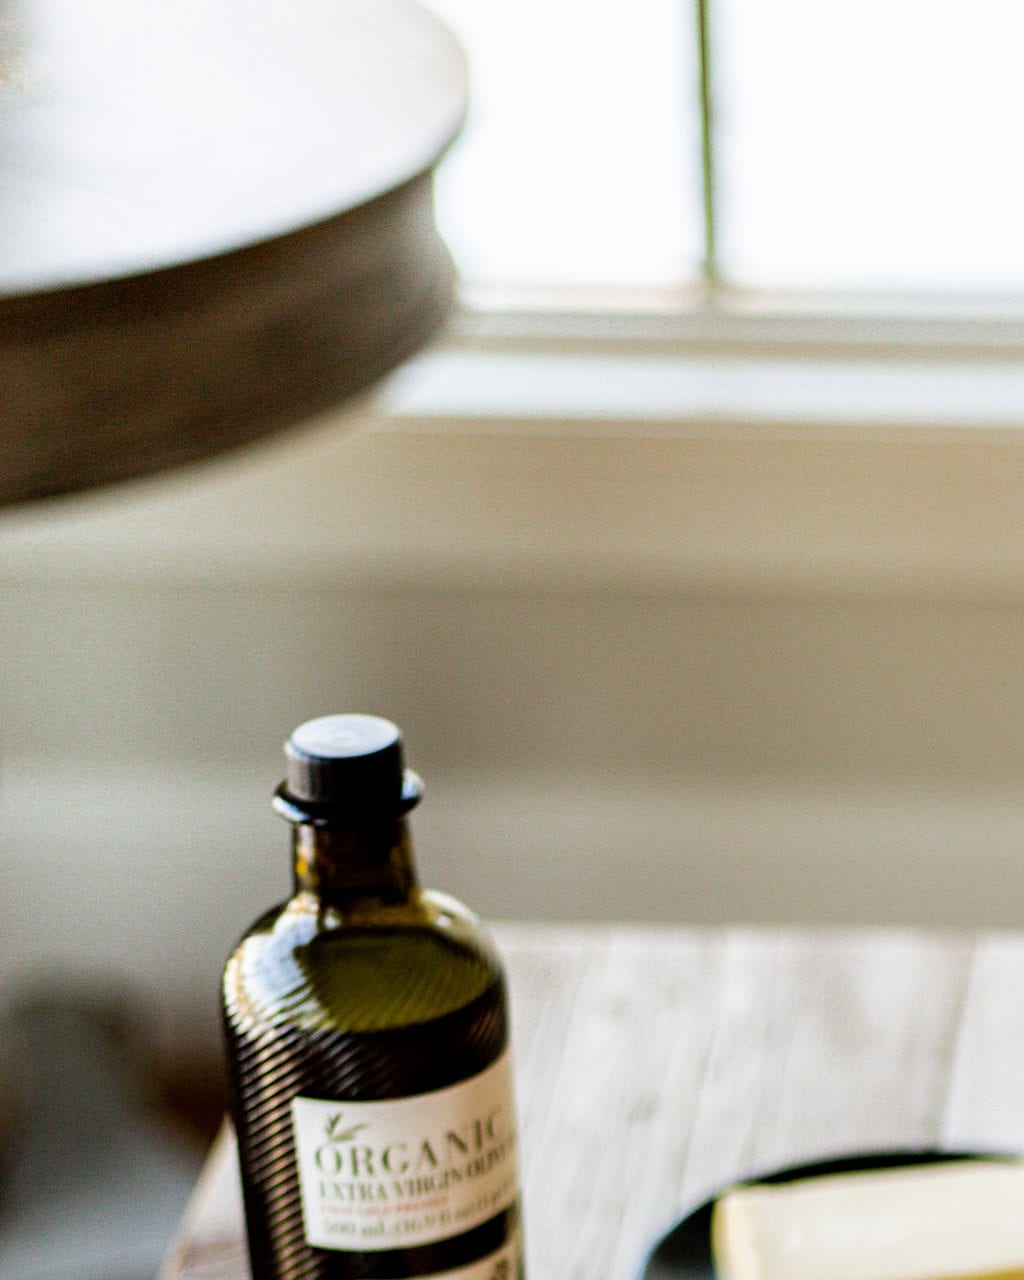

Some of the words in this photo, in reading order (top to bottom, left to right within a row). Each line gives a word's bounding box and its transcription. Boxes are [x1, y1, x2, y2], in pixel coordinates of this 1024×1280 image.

[314, 1104, 503, 1177] ORGANIC
[318, 1180, 388, 1202] EXTRA
[390, 1166, 464, 1198] VIRGIN
